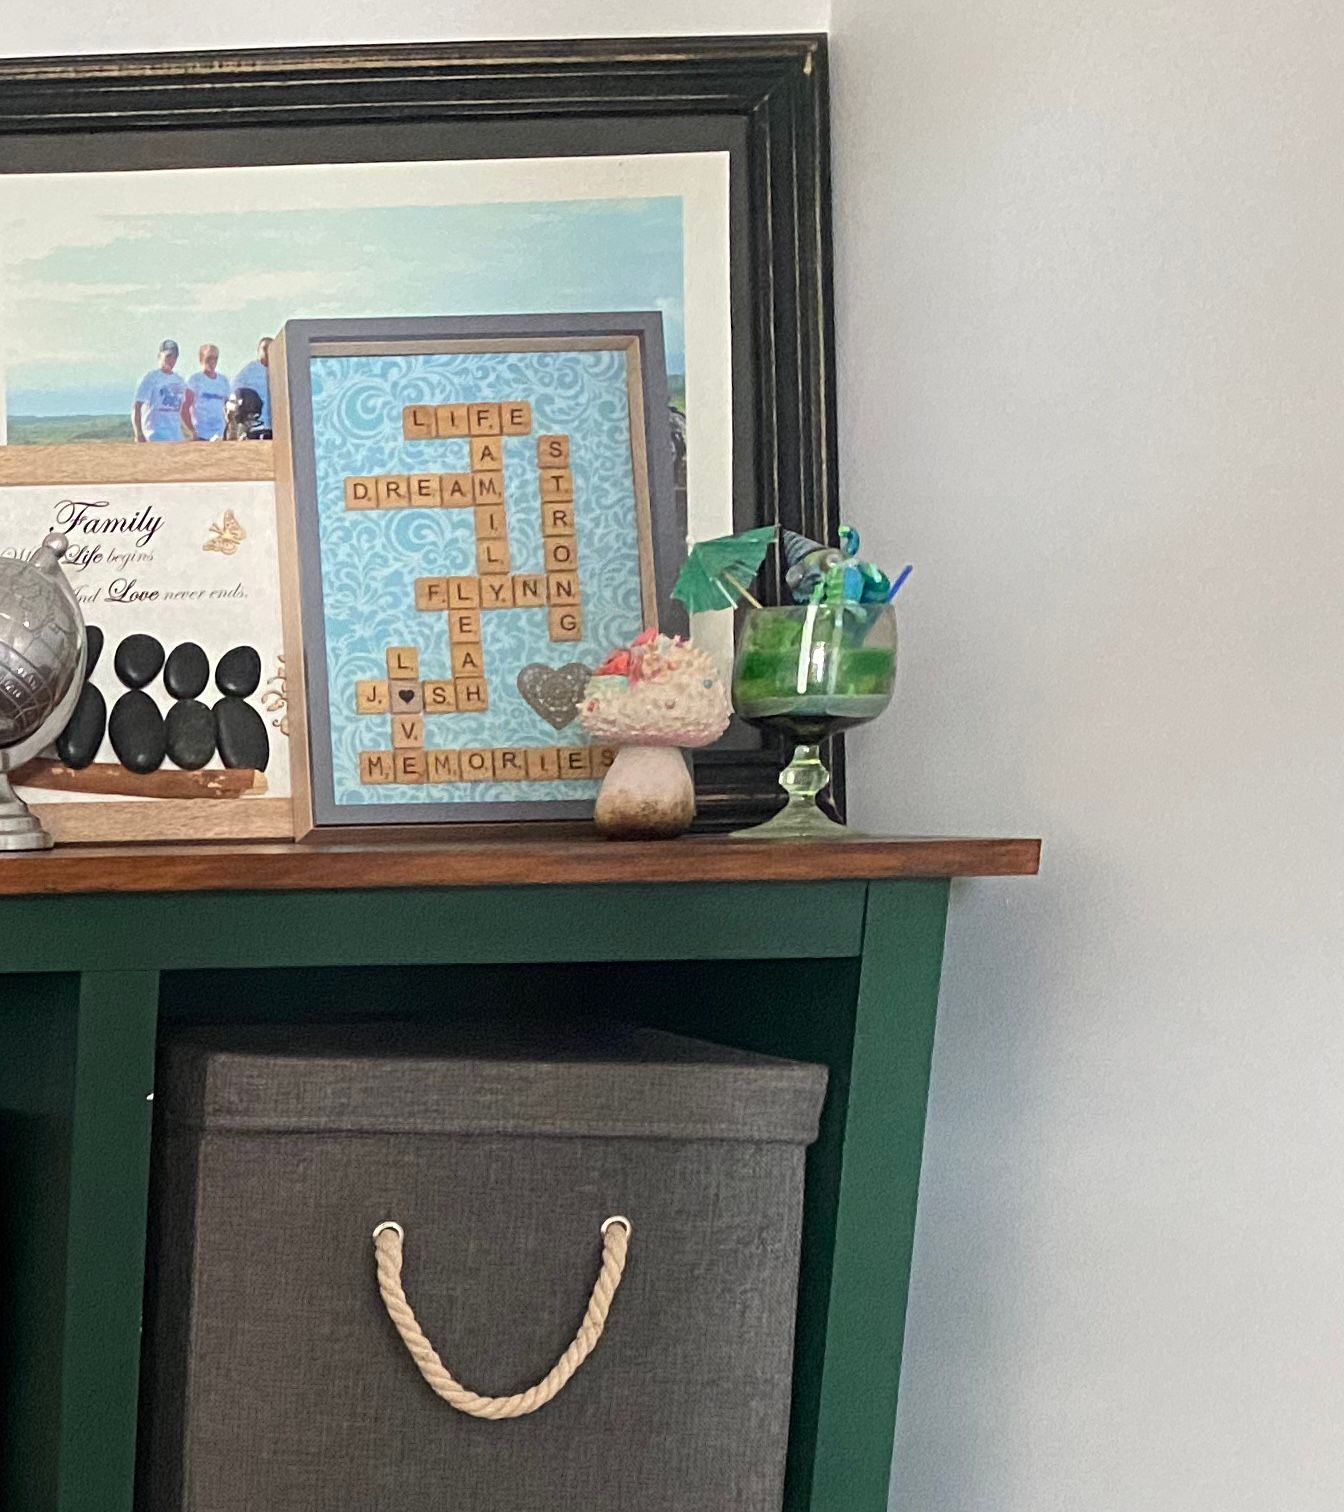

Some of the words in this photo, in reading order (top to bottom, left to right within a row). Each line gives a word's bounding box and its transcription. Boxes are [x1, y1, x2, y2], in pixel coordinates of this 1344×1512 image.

[413, 408, 524, 428] LIFE
[353, 477, 496, 501] DREAM
[49, 500, 165, 548] Family
[550, 441, 577, 632] STRONG
[61, 544, 104, 573] Life
[107, 549, 155, 572] begins
[104, 577, 160, 604] Love
[164, 588, 204, 602] never
[427, 579, 573, 602] FLYNN
